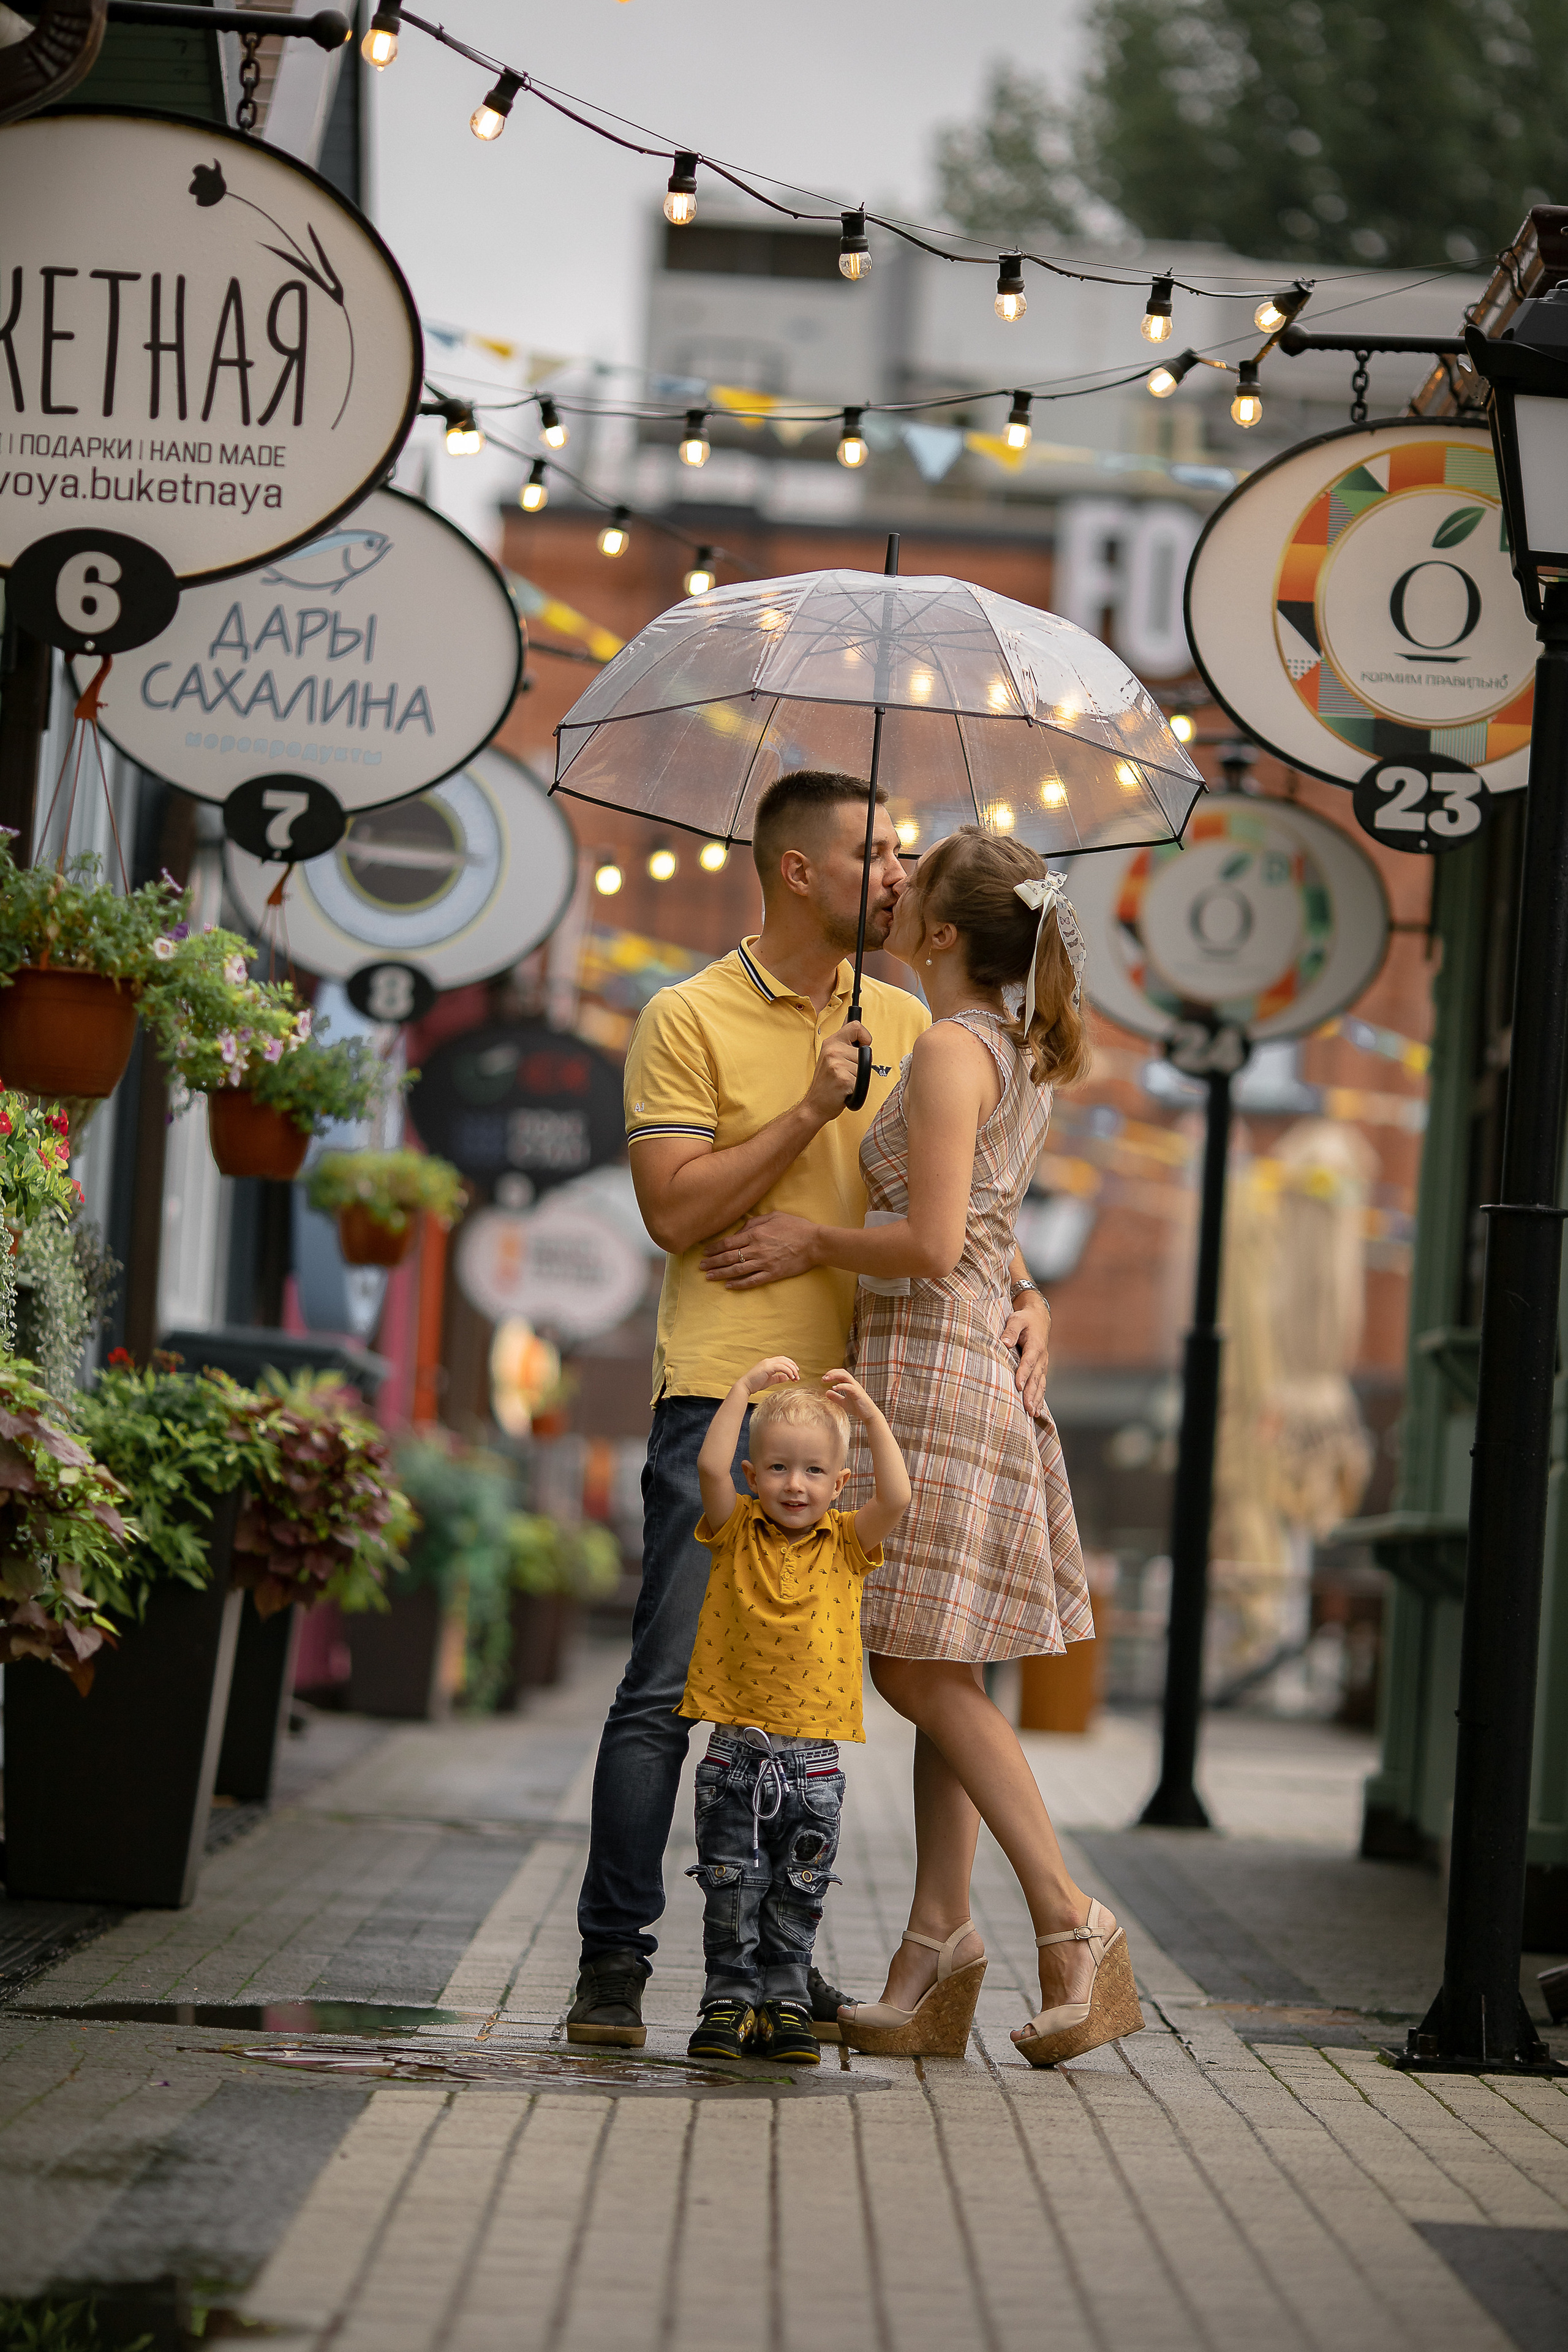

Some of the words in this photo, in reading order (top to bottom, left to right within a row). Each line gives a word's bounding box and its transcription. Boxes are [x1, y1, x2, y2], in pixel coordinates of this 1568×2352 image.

[20, 432, 132, 459] ПОДАРКИ
[149, 439, 212, 463] HAND
[219, 443, 286, 467] MADE
[56, 551, 122, 635] 6
[209, 601, 377, 663] ДАРЫ
[141, 661, 436, 735] САХАЛИНА
[262, 790, 309, 850] 7
[1374, 766, 1482, 837] 23
[369, 967, 415, 1018] 8
